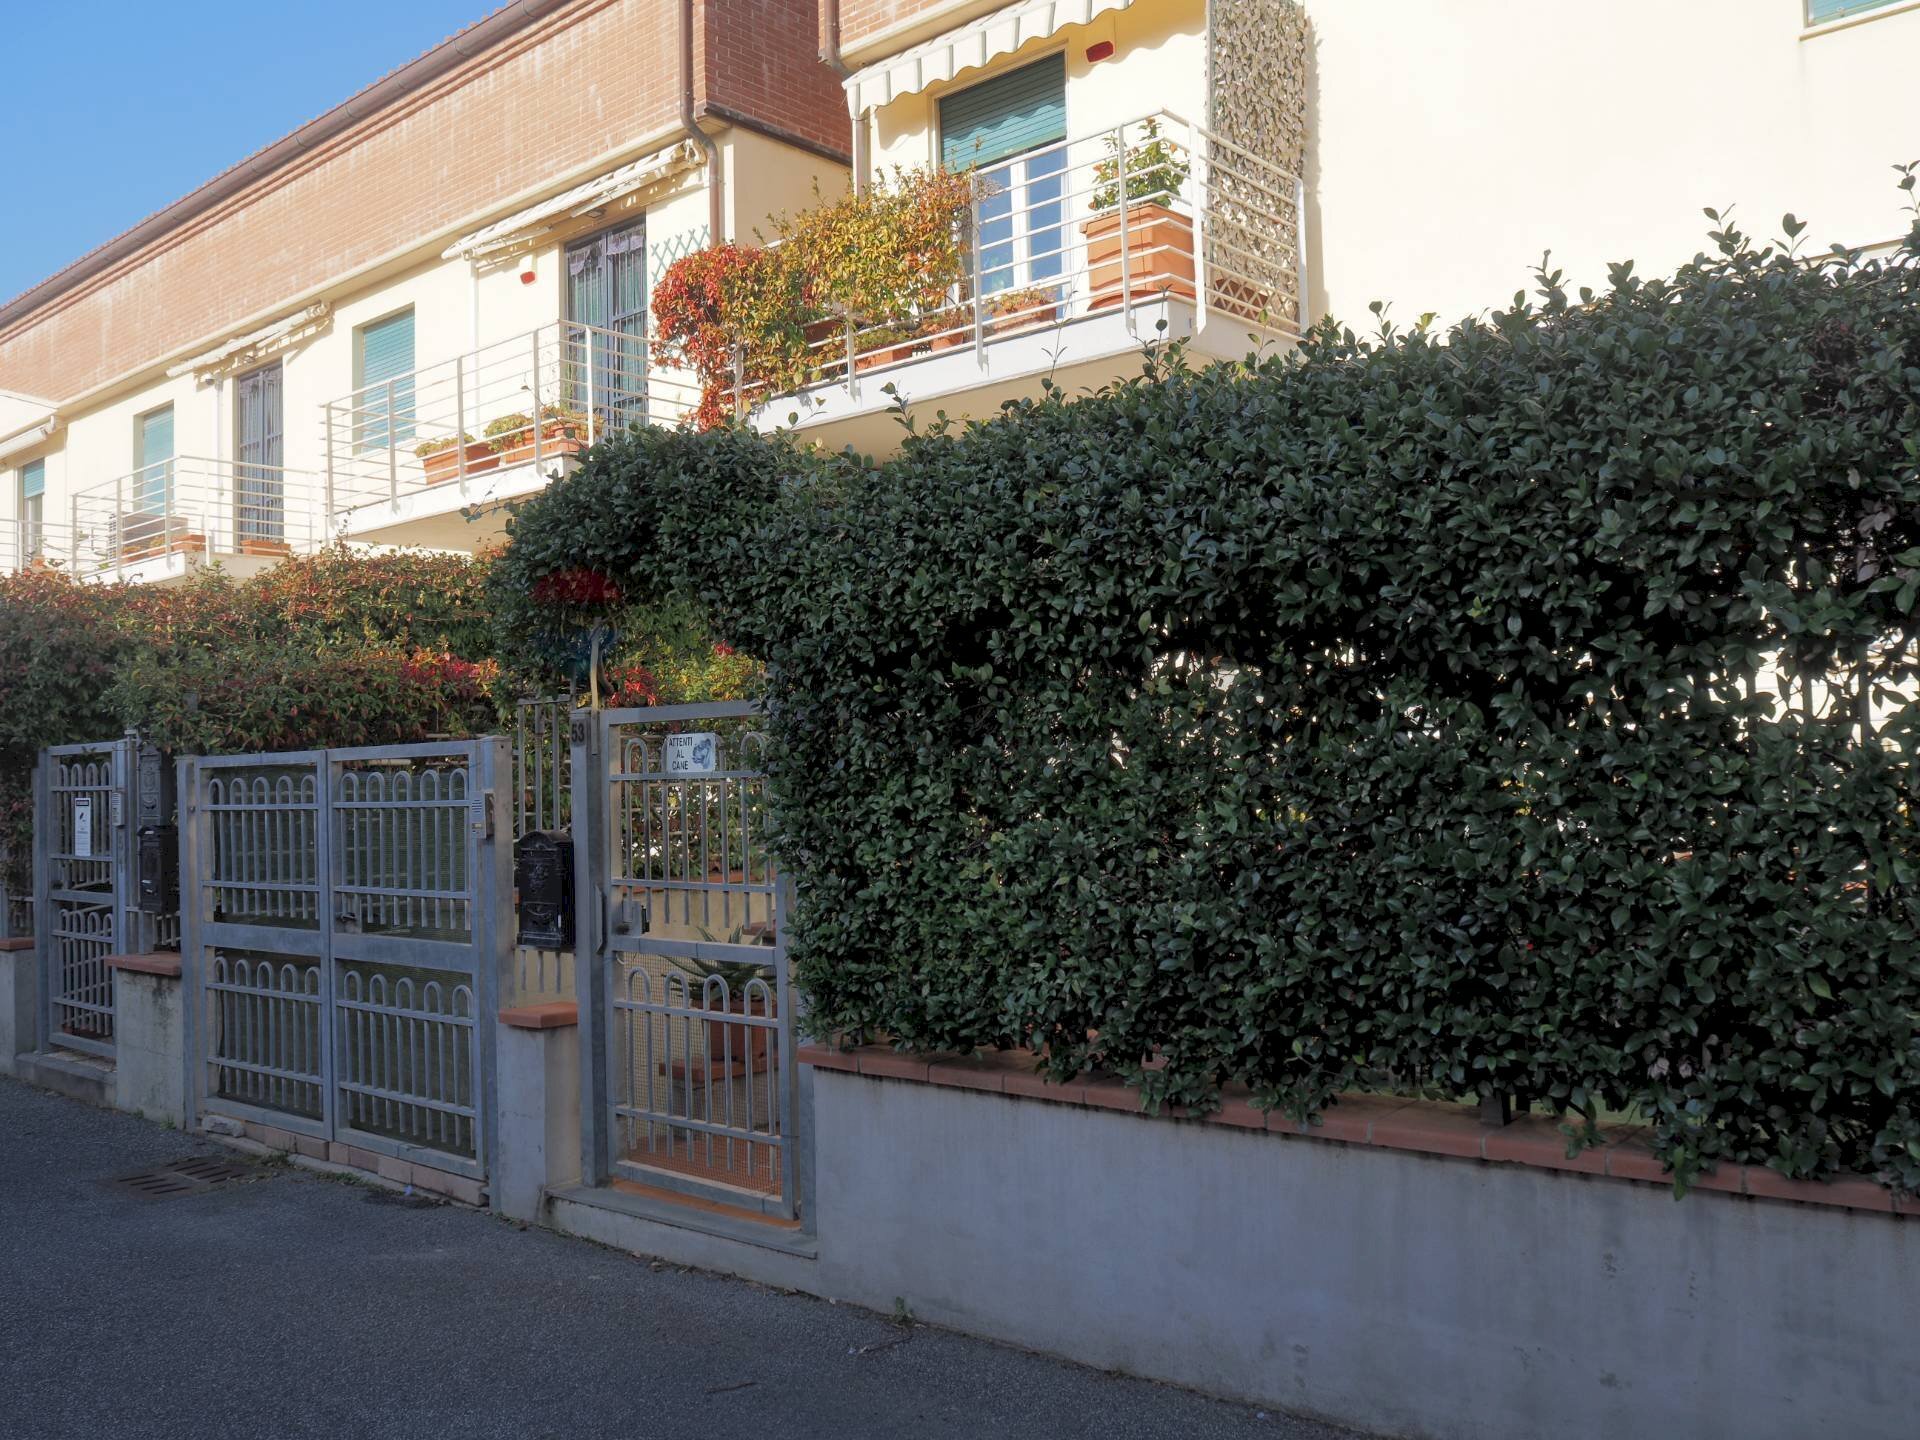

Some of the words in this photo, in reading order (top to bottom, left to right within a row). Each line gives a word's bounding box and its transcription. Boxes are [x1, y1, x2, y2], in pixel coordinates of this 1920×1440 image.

[571, 723, 584, 742] 53
[668, 736, 693, 747] ATTENTI
[676, 749, 685, 758] AL
[672, 761, 689, 771] CANE
